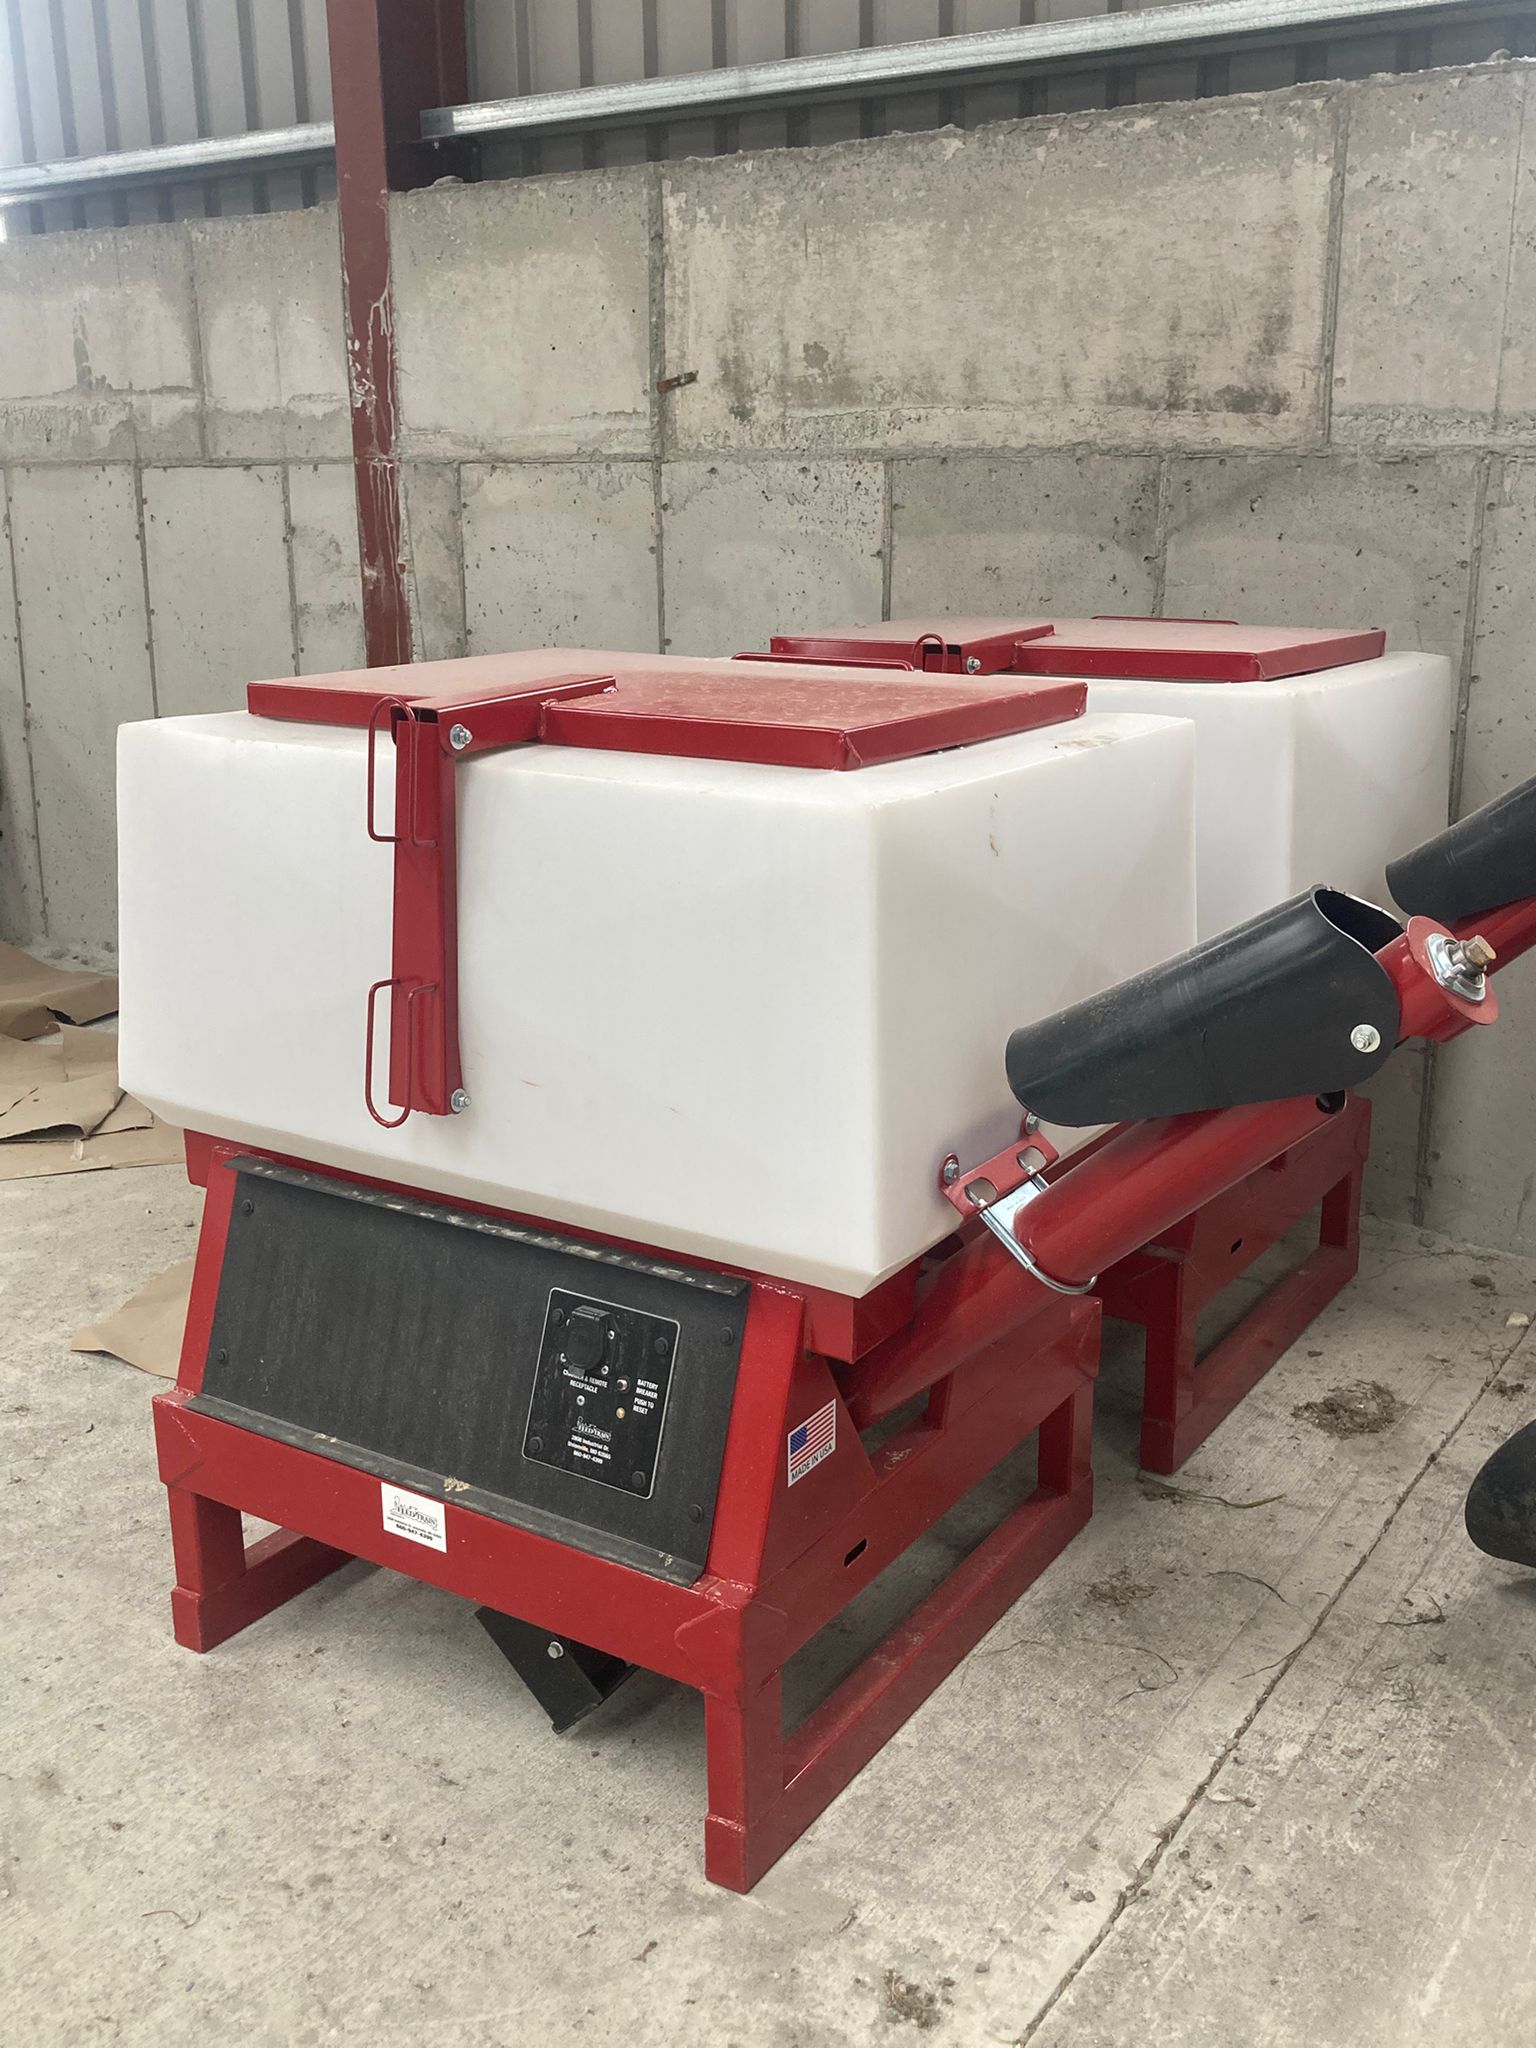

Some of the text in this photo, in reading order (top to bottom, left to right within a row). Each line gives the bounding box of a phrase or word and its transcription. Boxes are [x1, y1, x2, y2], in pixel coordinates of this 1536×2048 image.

[570, 1380, 598, 1394] RECEPTACLE
[589, 1376, 608, 1388] REMOTE
[637, 1378, 658, 1390] BATTERY
[636, 1386, 658, 1399] BREAKER
[634, 1397, 654, 1408] PUSH TO
[632, 1404, 648, 1415] RESET
[582, 1438, 603, 1449] Industrial
[791, 1444, 833, 1482] MADE IN USA
